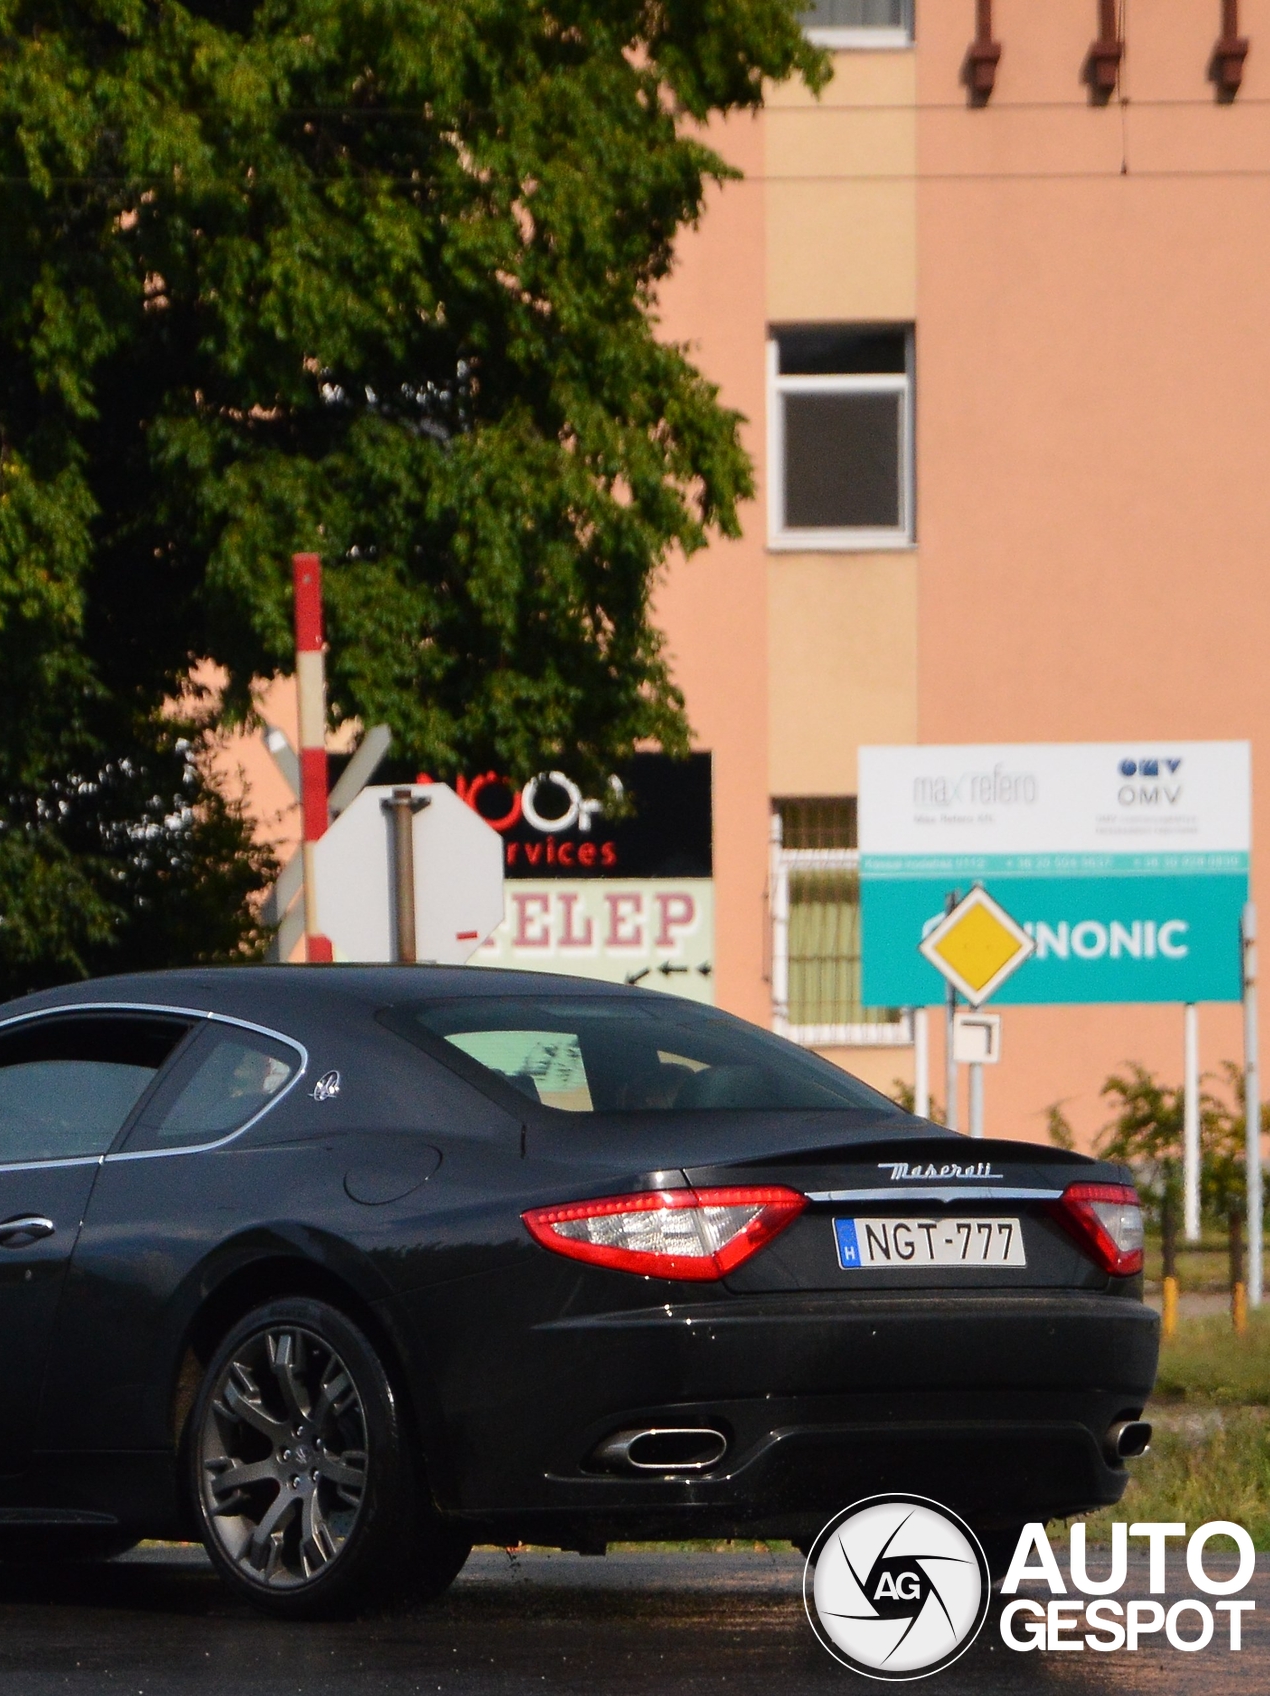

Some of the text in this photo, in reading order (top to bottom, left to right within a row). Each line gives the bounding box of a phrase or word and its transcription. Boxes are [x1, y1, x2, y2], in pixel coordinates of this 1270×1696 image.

[1116, 784, 1183, 807] OMV
[506, 835, 618, 868] rvices
[484, 892, 696, 948] ELEP
[1024, 919, 1189, 959] NONIC
[877, 1162, 1004, 1180] Maserati
[845, 1246, 856, 1261] H
[865, 1222, 1014, 1261] NGT-777
